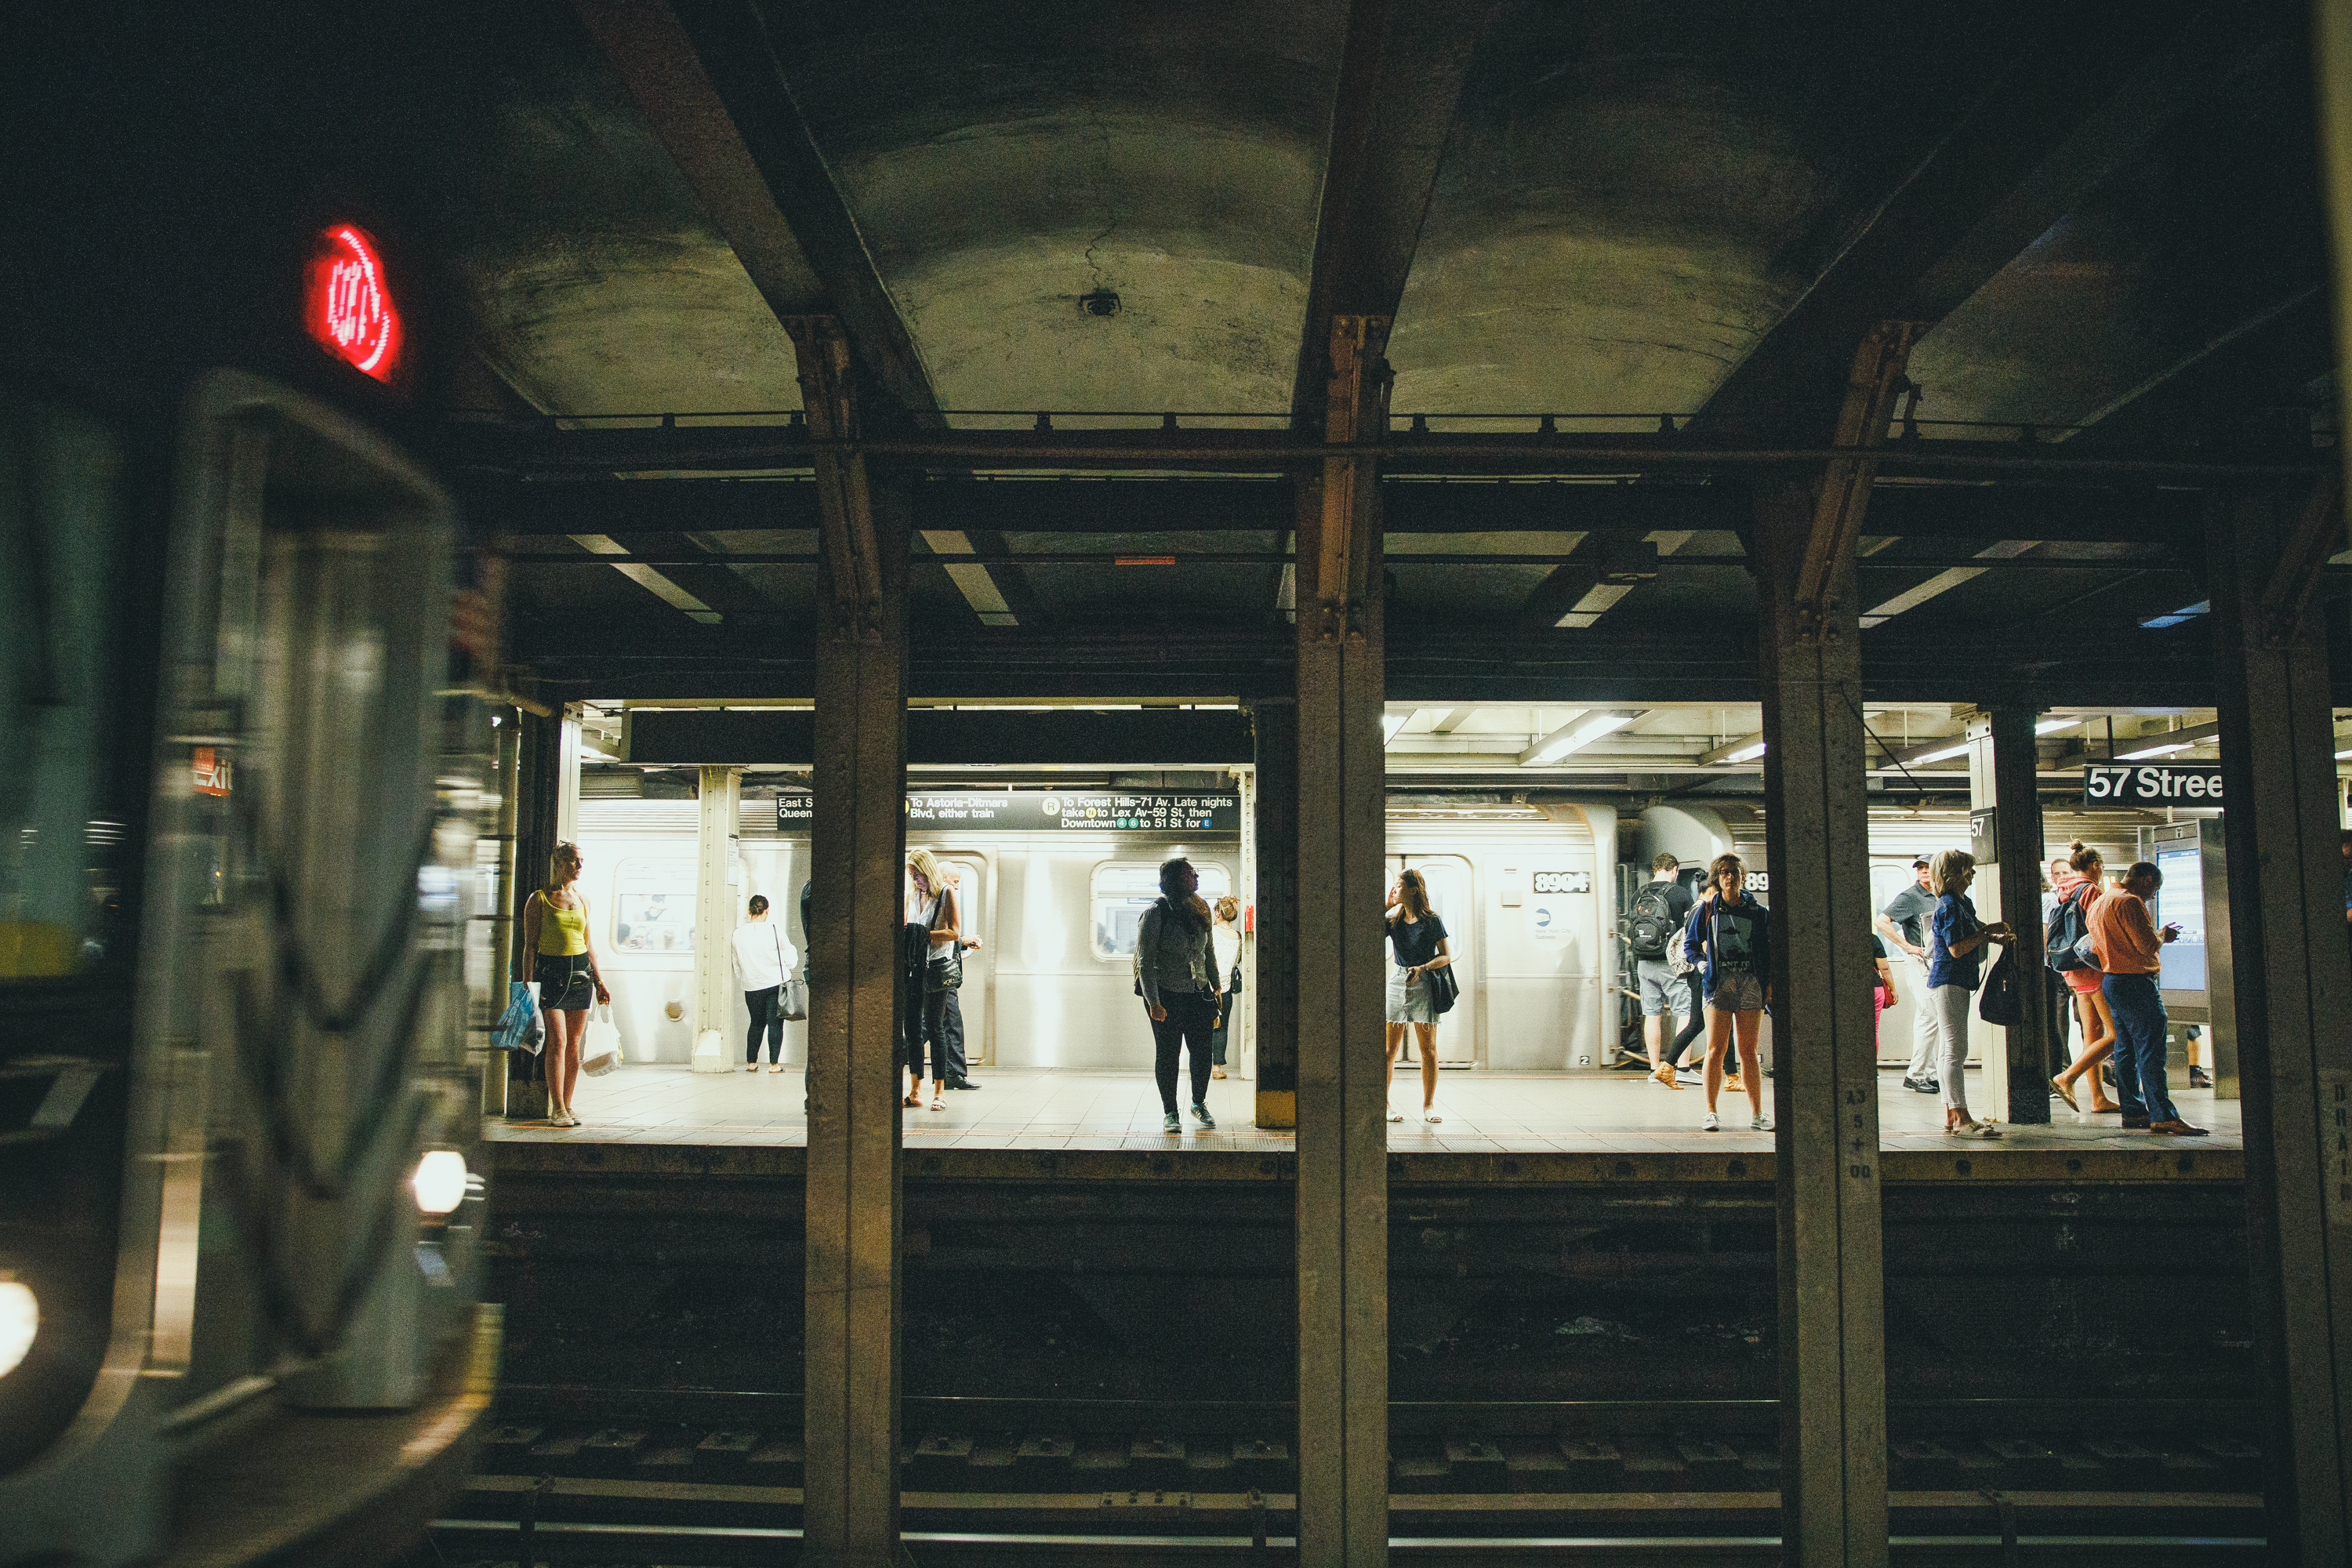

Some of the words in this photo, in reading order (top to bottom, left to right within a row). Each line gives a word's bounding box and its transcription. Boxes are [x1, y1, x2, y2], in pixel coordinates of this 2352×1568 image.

[2088, 768, 2131, 797] 57
[2136, 767, 2223, 798] Stree
[779, 798, 802, 808] East
[805, 797, 813, 808] S
[910, 797, 923, 808] To
[927, 797, 1008, 808] Astoria-Ditmars
[1061, 797, 1074, 807] To
[1078, 797, 1111, 807] Forest
[1115, 797, 1152, 807] Hills-71
[1156, 797, 1171, 807] Av.
[1174, 797, 1197, 807] Late
[1201, 797, 1232, 808] nights
[779, 808, 813, 818] Queen
[910, 808, 935, 819] Blvd,
[938, 808, 968, 818] either
[971, 809, 994, 818] train
[1062, 808, 1085, 817] take
[1097, 808, 1108, 817] to
[1112, 808, 1131, 817] Lex
[1134, 808, 1167, 817] Av-59
[1171, 808, 1185, 818] St,
[1189, 808, 1212, 817] then
[1061, 818, 1116, 828] Downtown
[1140, 818, 1151, 828] to
[1155, 818, 1166, 828] 51
[1170, 818, 1181, 828] St
[1185, 818, 1200, 828] for
[1971, 817, 1984, 837] 57
[1535, 873, 1588, 891] 8904
[1744, 873, 1769, 891] 89
[1580, 1056, 1589, 1065] 2
